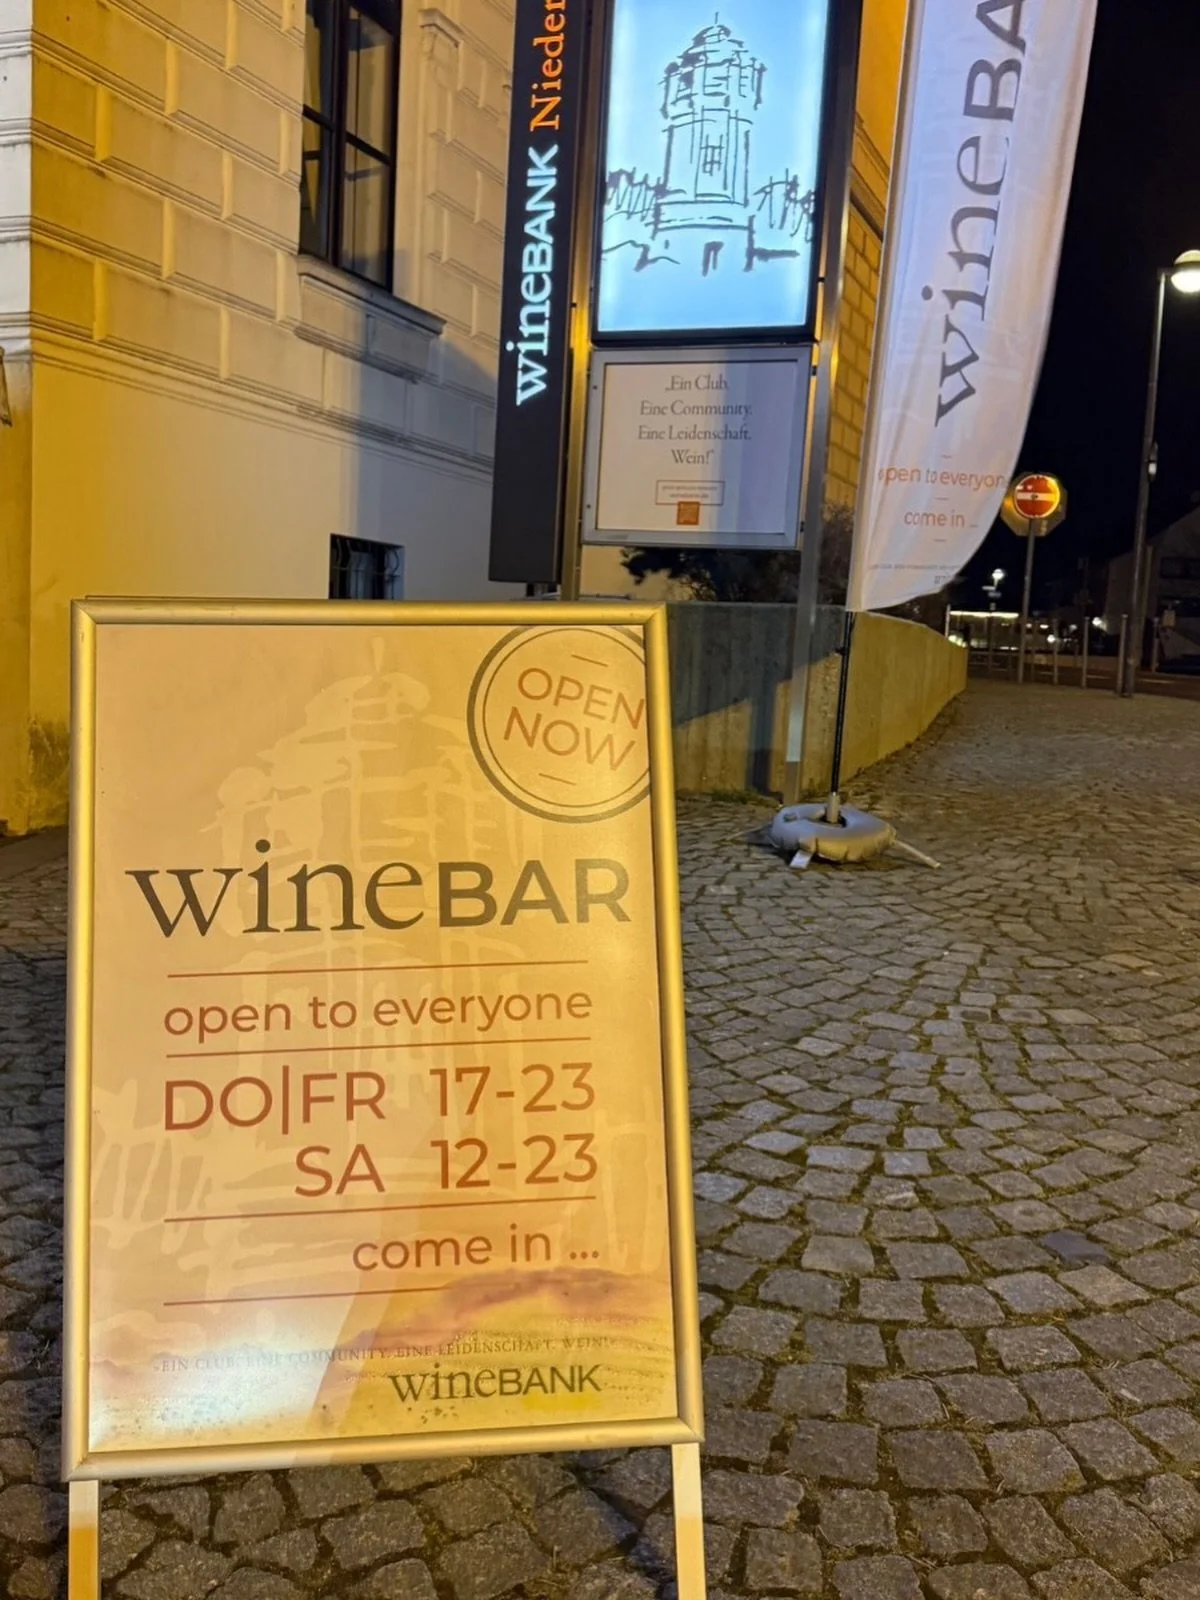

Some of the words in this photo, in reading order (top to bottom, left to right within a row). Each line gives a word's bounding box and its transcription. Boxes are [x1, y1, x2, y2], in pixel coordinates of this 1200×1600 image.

[506, 144, 560, 406] wineBANK
[637, 424, 666, 440] Eine
[640, 399, 669, 416] Eine
[925, 468, 938, 484] to
[904, 511, 947, 527] come
[951, 509, 965, 528] in
[517, 667, 646, 730] OPEN
[503, 706, 637, 771] NOW
[125, 839, 632, 938] wineBAR
[163, 1003, 292, 1044] open
[309, 994, 358, 1028] to
[373, 990, 593, 1033] everyone
[430, 1062, 596, 1117] 17-23
[294, 1143, 387, 1197] SA
[430, 1133, 598, 1191] 12-23
[352, 1233, 493, 1271] come
[509, 1223, 552, 1263] in
[388, 1362, 603, 1402] wineBANK
